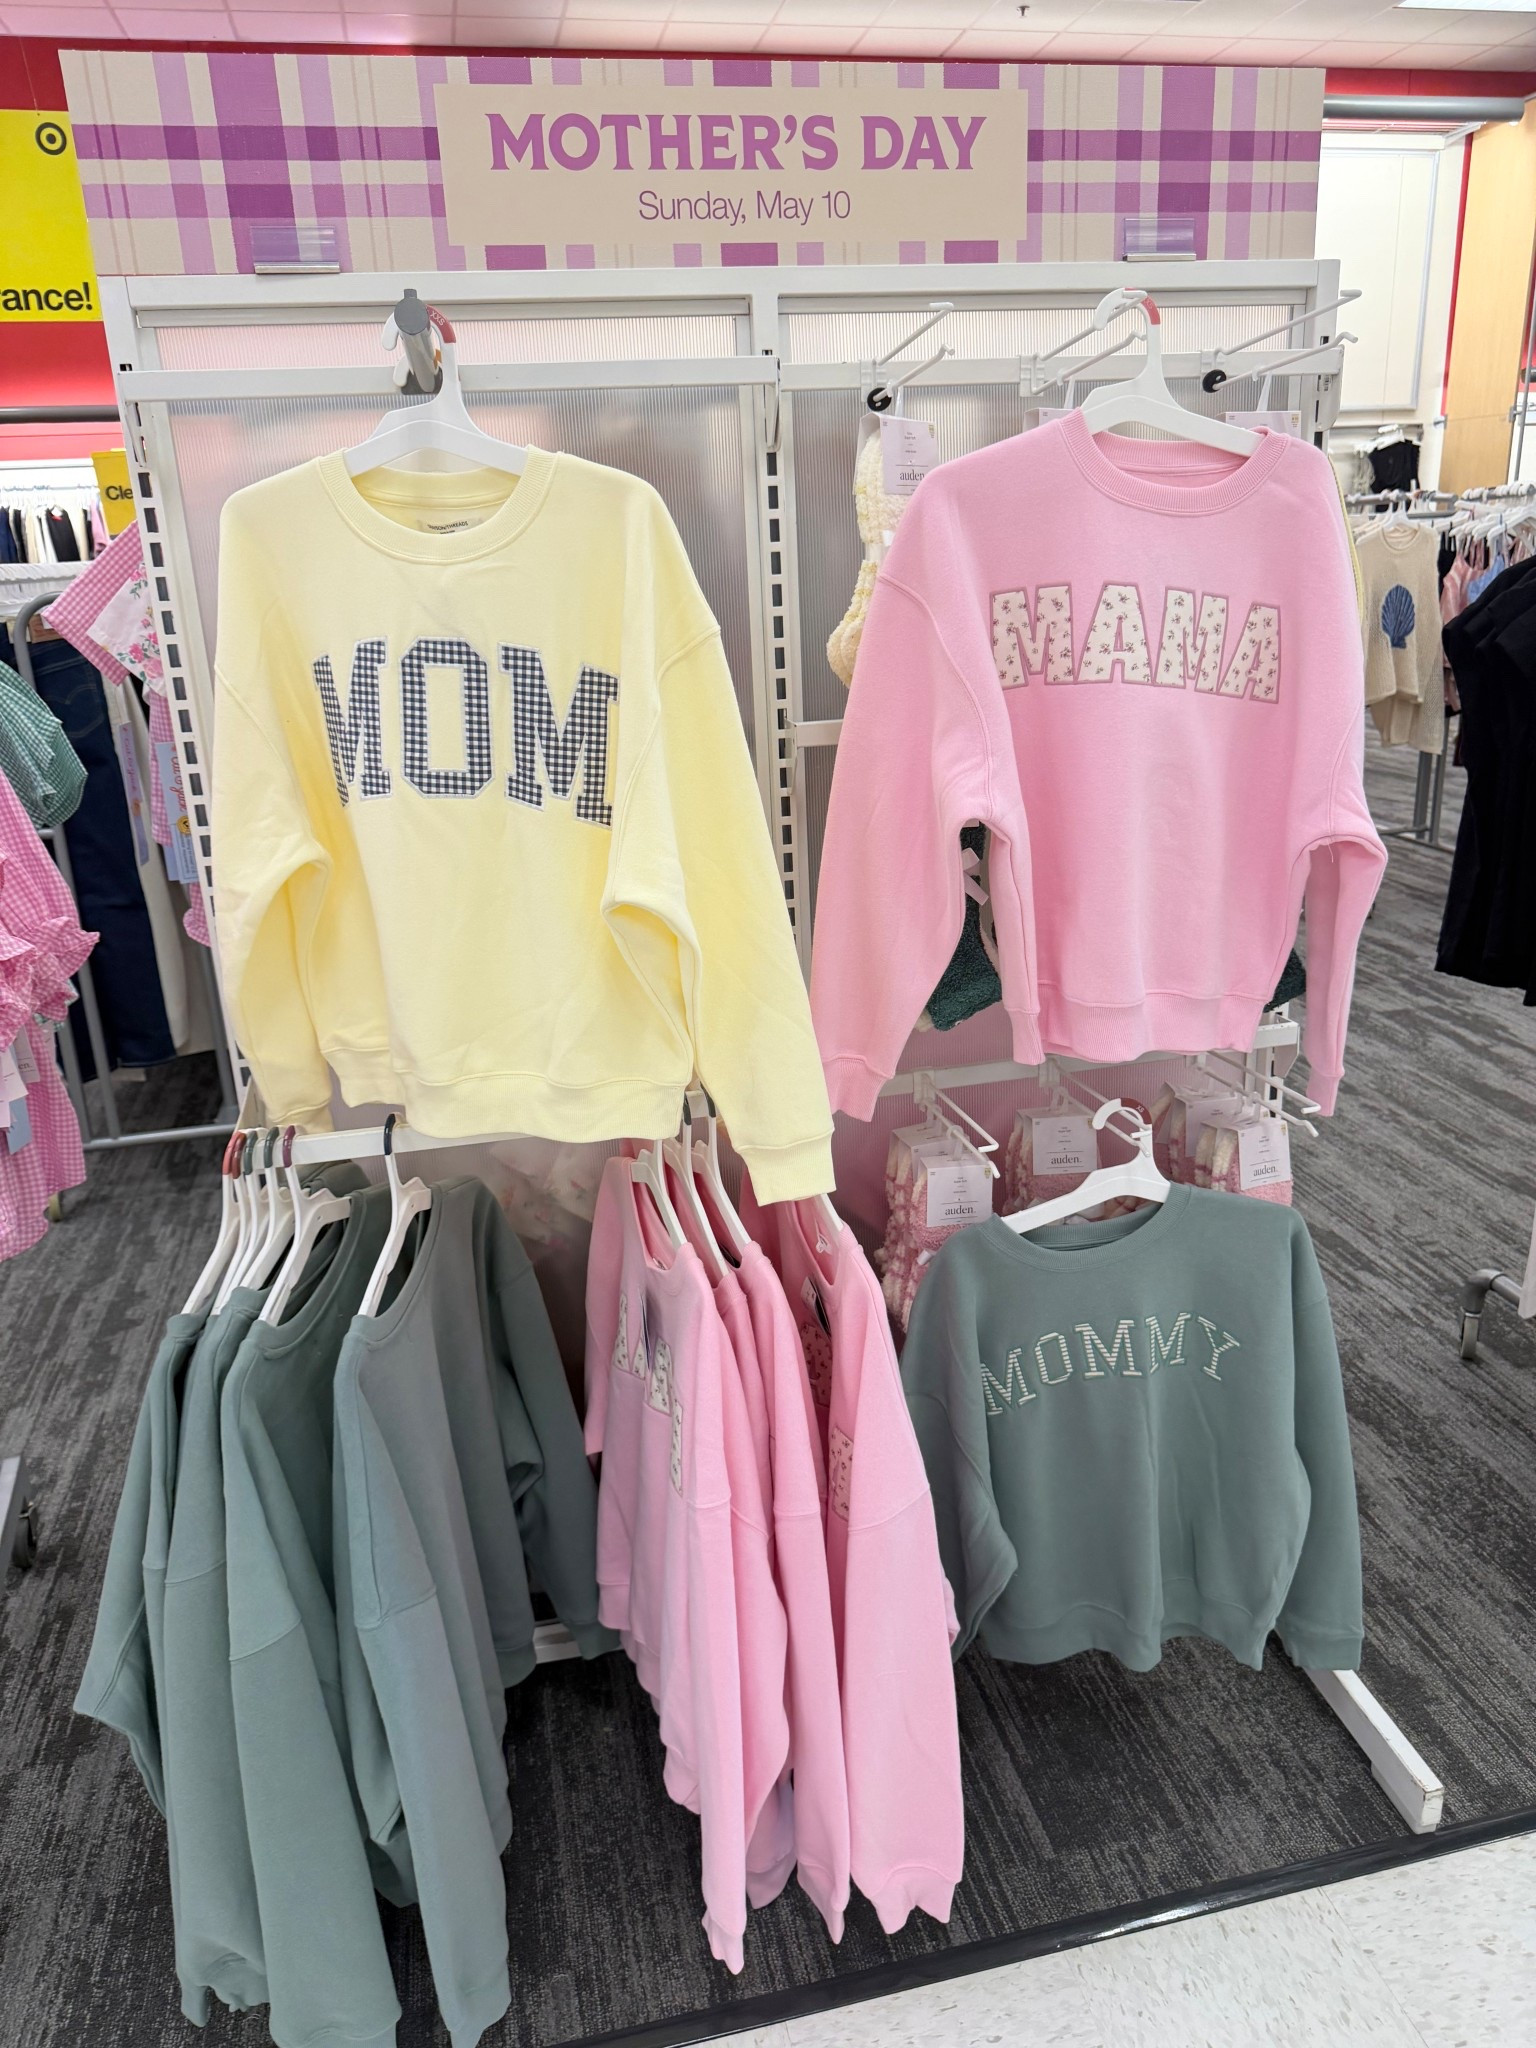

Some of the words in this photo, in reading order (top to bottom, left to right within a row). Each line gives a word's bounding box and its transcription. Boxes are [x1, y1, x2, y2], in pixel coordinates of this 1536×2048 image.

[485, 113, 839, 171] MOTHER’S
[860, 115, 988, 170] DAY
[638, 190, 747, 227] Sunday,
[755, 190, 814, 226] May
[821, 190, 851, 219] 10
[0, 281, 93, 311] ance!
[430, 310, 446, 326] XXS
[989, 580, 1280, 704] MAMA
[312, 635, 620, 827] MOM
[981, 1312, 1241, 1416] MOMMY
